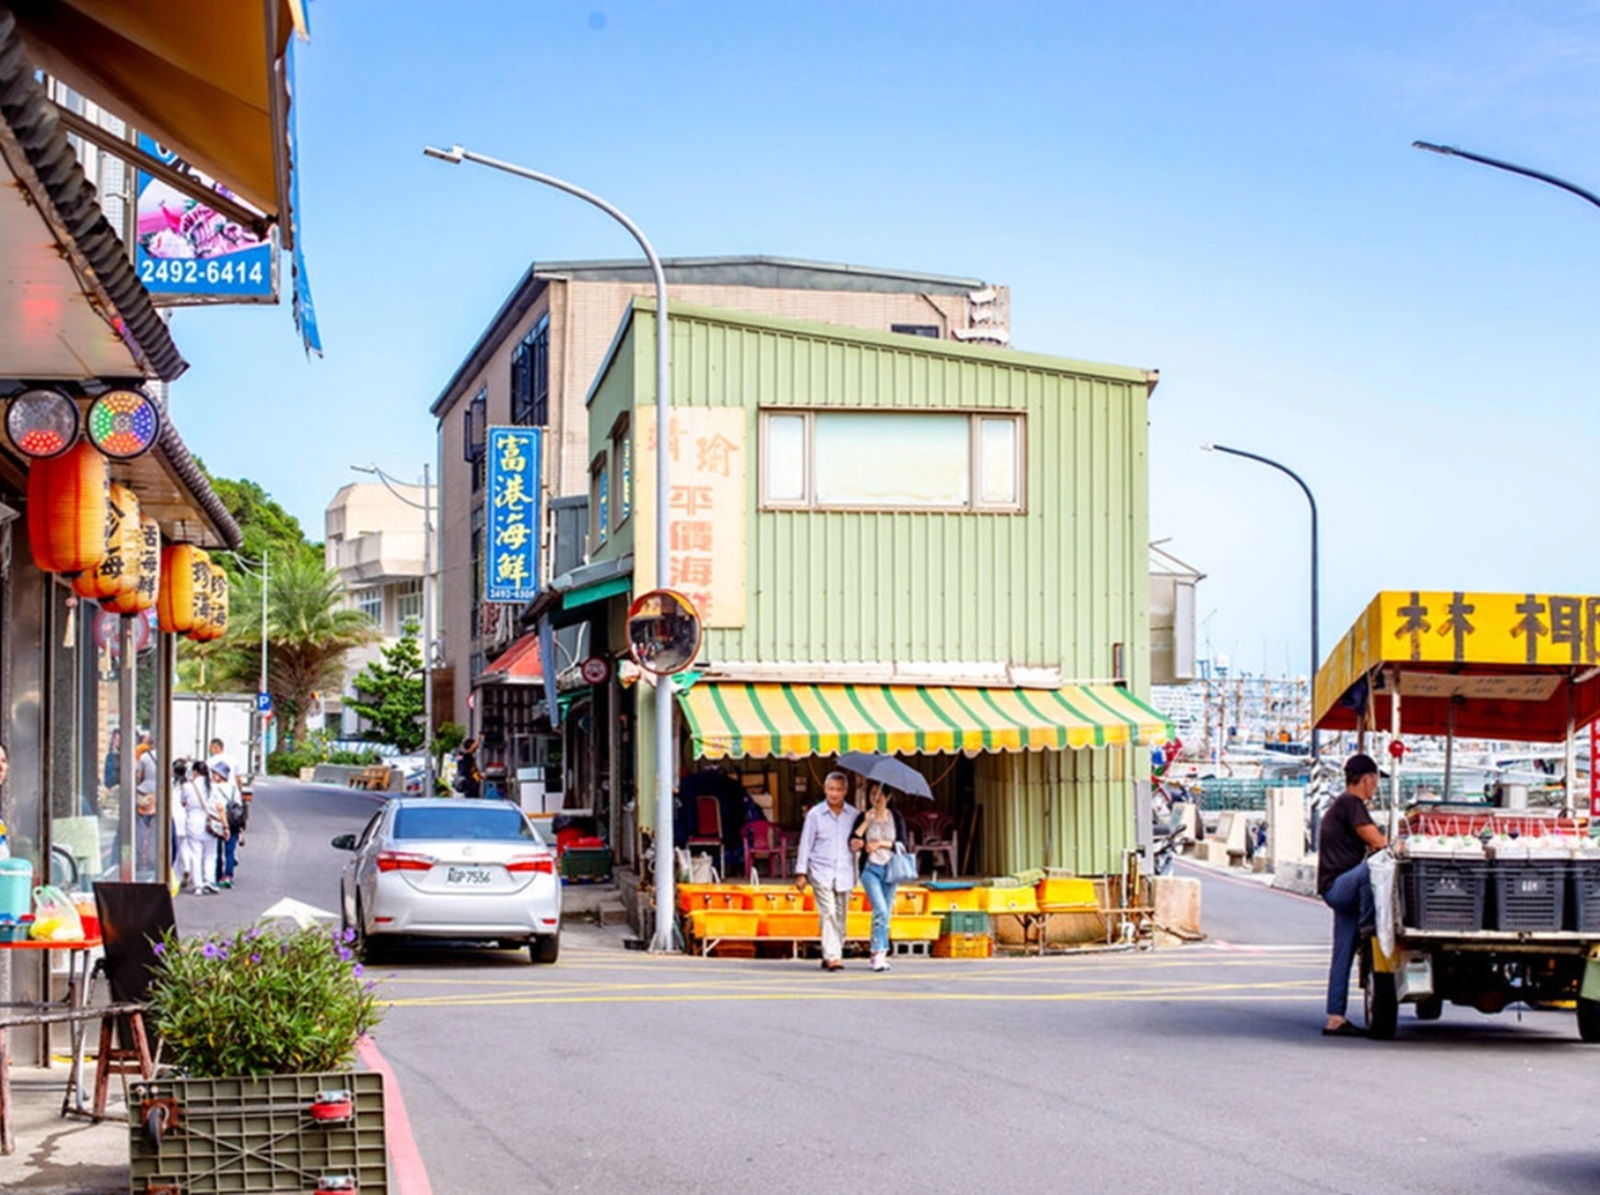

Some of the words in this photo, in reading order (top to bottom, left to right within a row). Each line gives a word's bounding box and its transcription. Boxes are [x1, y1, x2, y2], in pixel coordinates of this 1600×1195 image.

[141, 261, 263, 284] 2492-6414
[495, 434, 534, 589] 富港海鮮
[259, 695, 269, 708] P
